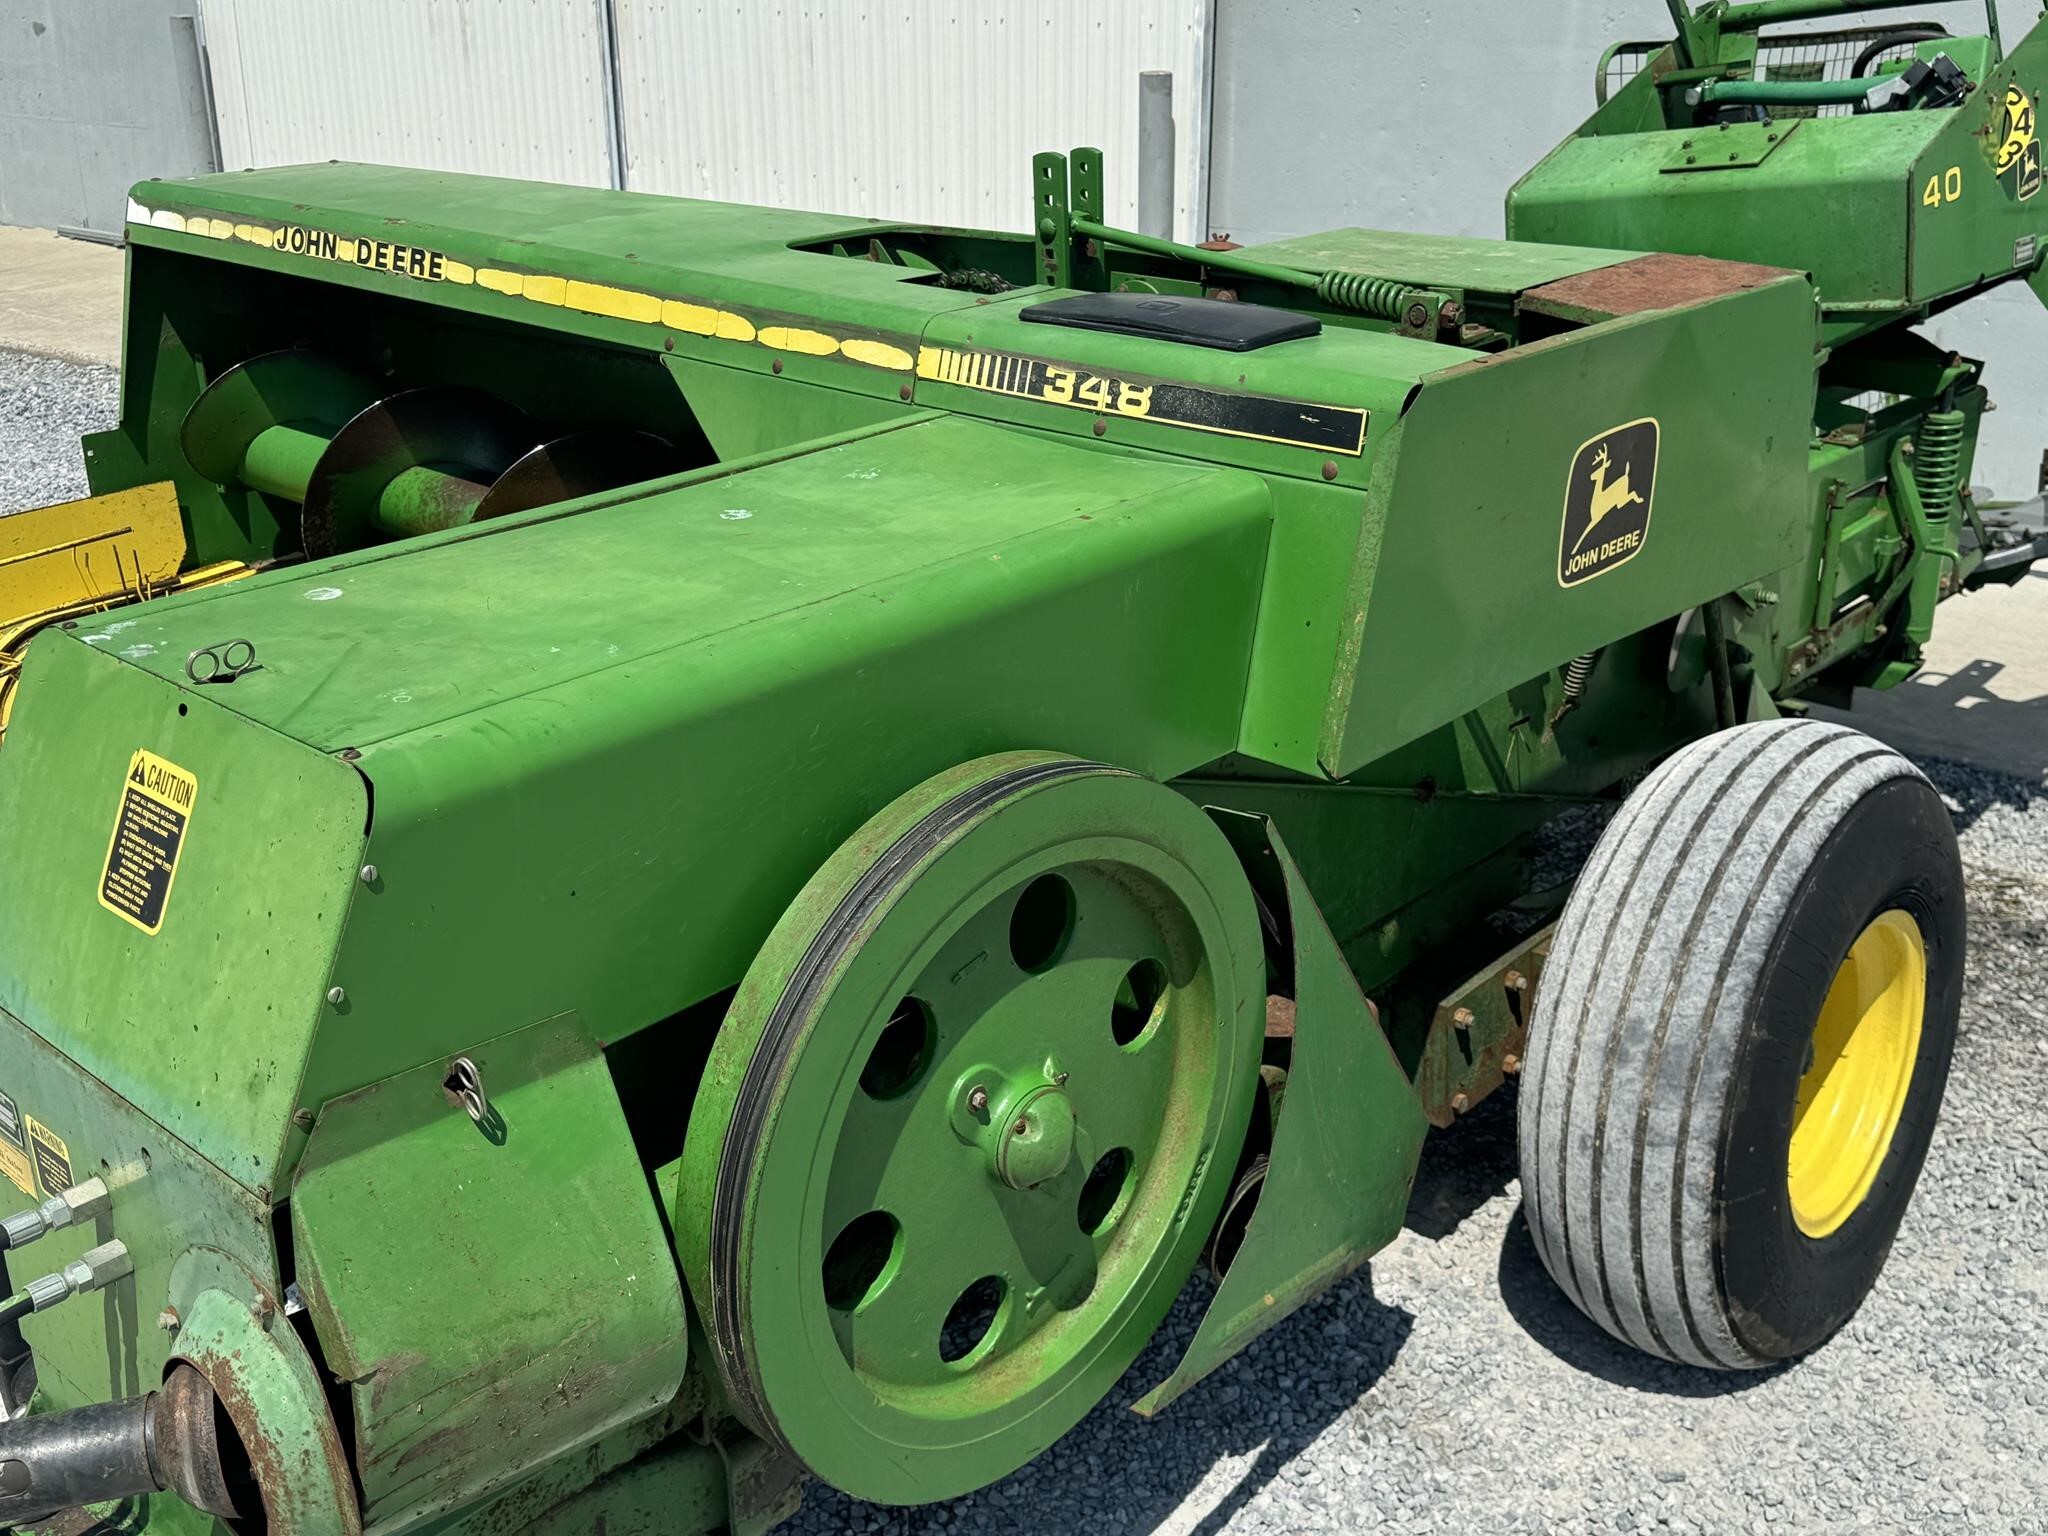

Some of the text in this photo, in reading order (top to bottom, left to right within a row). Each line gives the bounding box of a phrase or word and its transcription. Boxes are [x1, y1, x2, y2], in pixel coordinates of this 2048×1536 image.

[2013, 107, 2032, 135] 4
[1923, 166, 1962, 208] 40
[276, 226, 444, 279] JOHN DEERE
[1043, 366, 1153, 416] 348
[1565, 530, 1641, 576] JOHN DEERE
[146, 764, 194, 809] CAUTION
